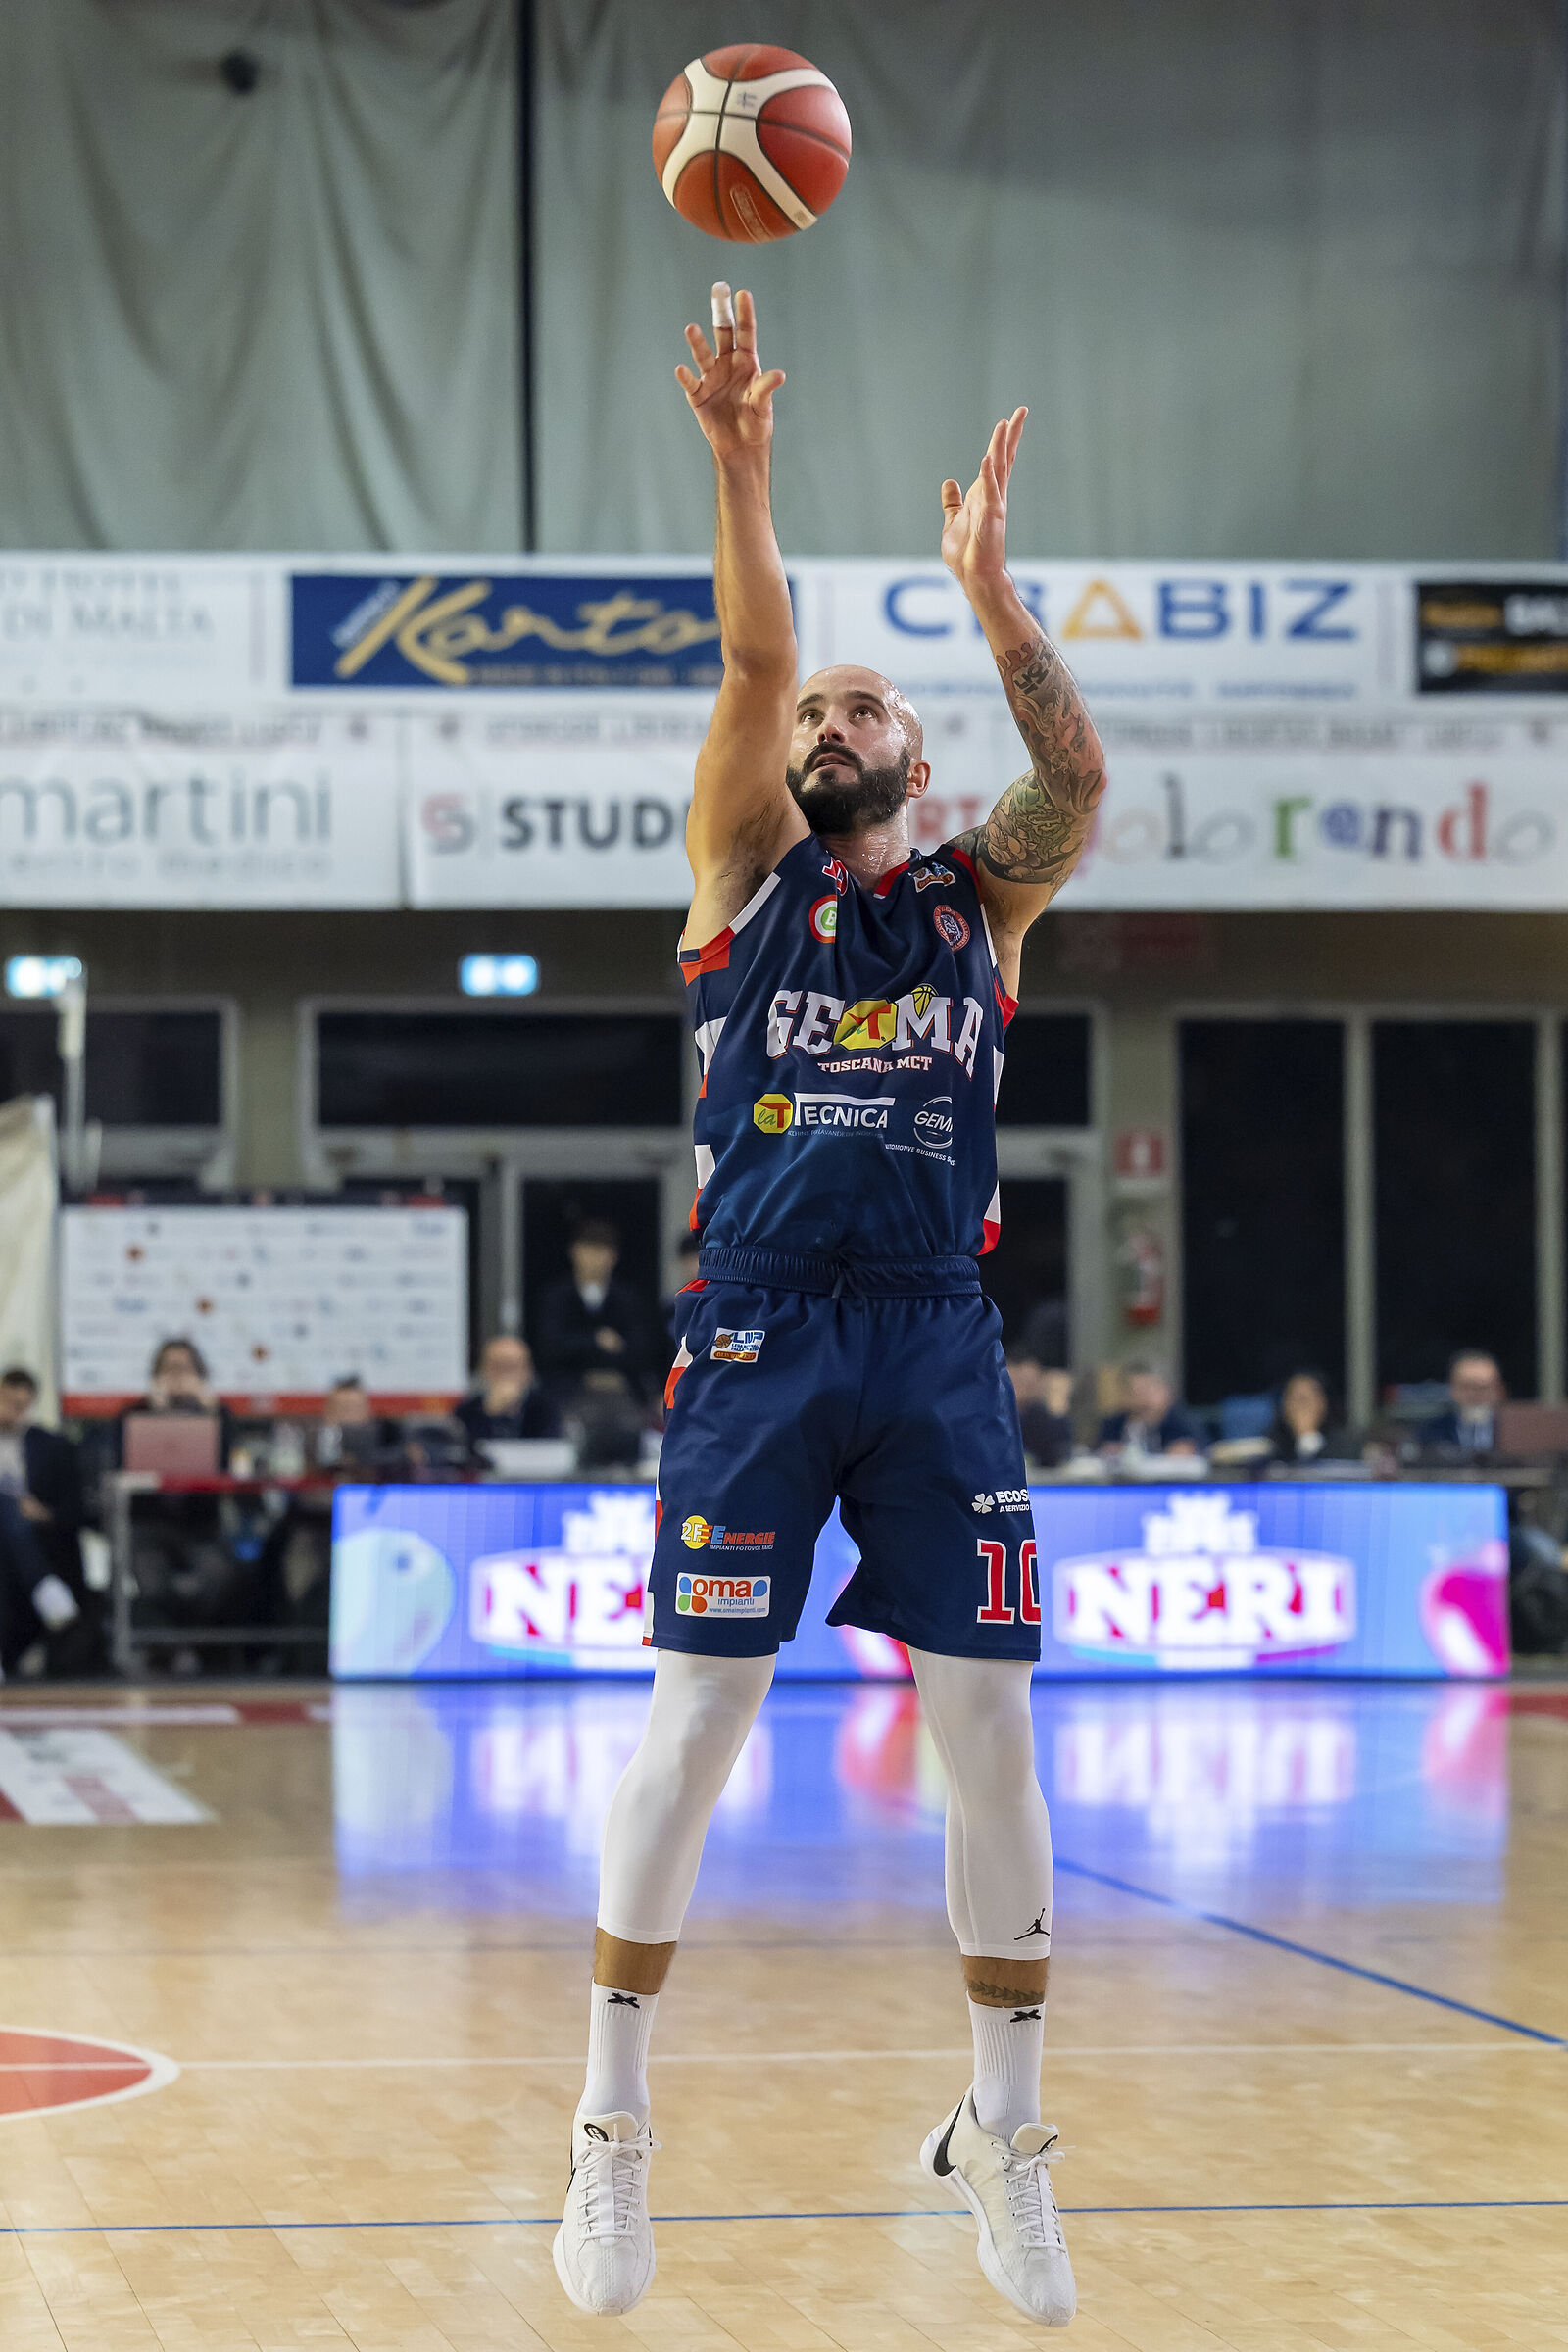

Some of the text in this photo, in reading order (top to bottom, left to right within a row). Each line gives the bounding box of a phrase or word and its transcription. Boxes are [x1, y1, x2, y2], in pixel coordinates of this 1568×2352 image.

[817, 1055, 933, 1074] TOSCANA MCT
[794, 1093, 896, 1129] TECNICA
[914, 1110, 954, 1133] GEM
[915, 1148, 947, 1161] BUSINESS
[733, 1332, 764, 1344] LNP
[710, 1525, 776, 1545] ENERGIE
[692, 1578, 752, 1598] oma
[717, 1597, 755, 1607] impianti
[1064, 1557, 1345, 1648] NERI
